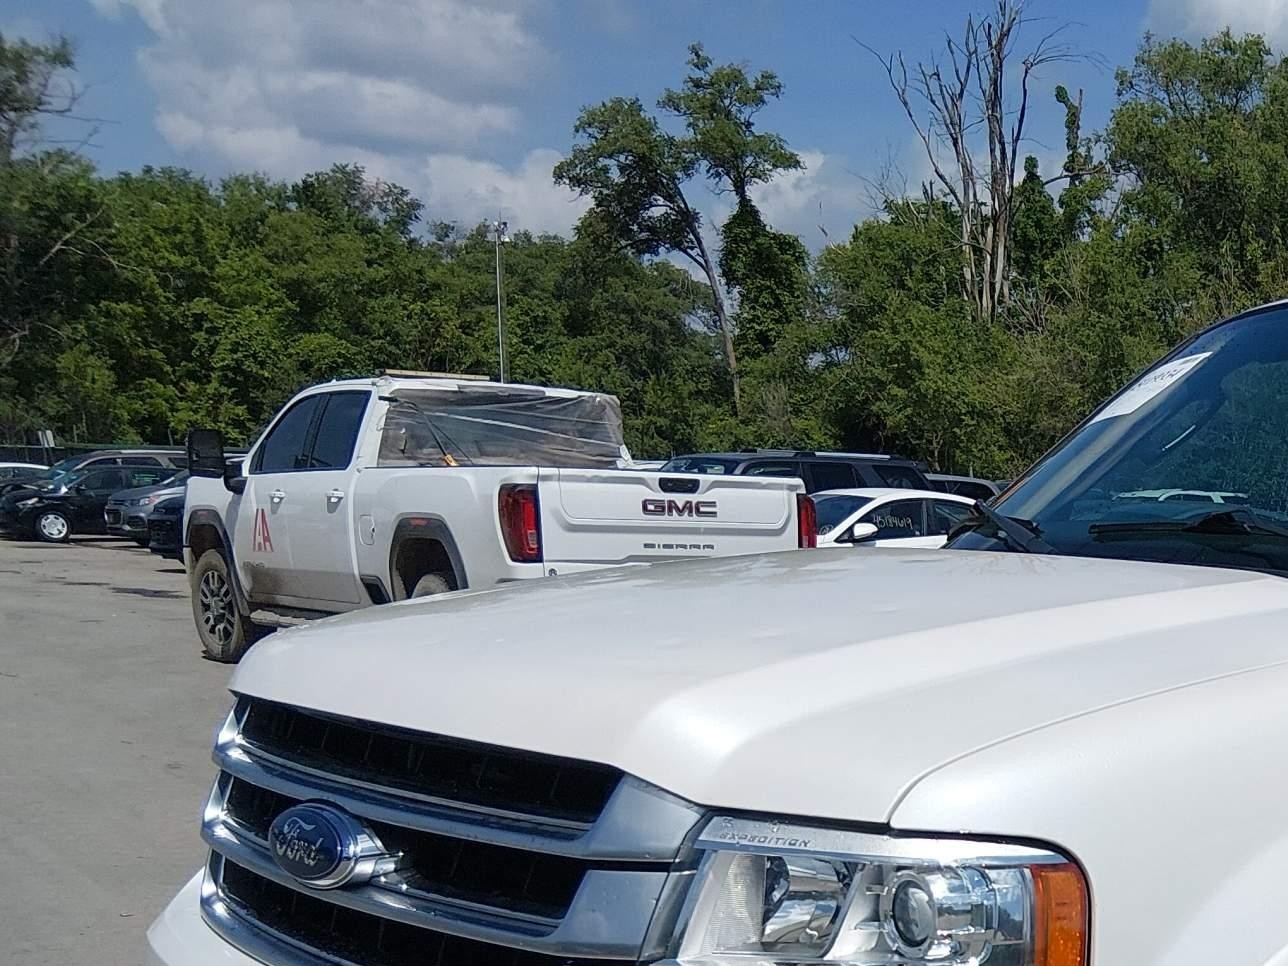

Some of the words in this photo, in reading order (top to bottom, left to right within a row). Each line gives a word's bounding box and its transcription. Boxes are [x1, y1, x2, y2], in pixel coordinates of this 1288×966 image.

[641, 498, 718, 518] GMC
[275, 816, 325, 866] Ford
[719, 832, 812, 848] EXPEDITION
